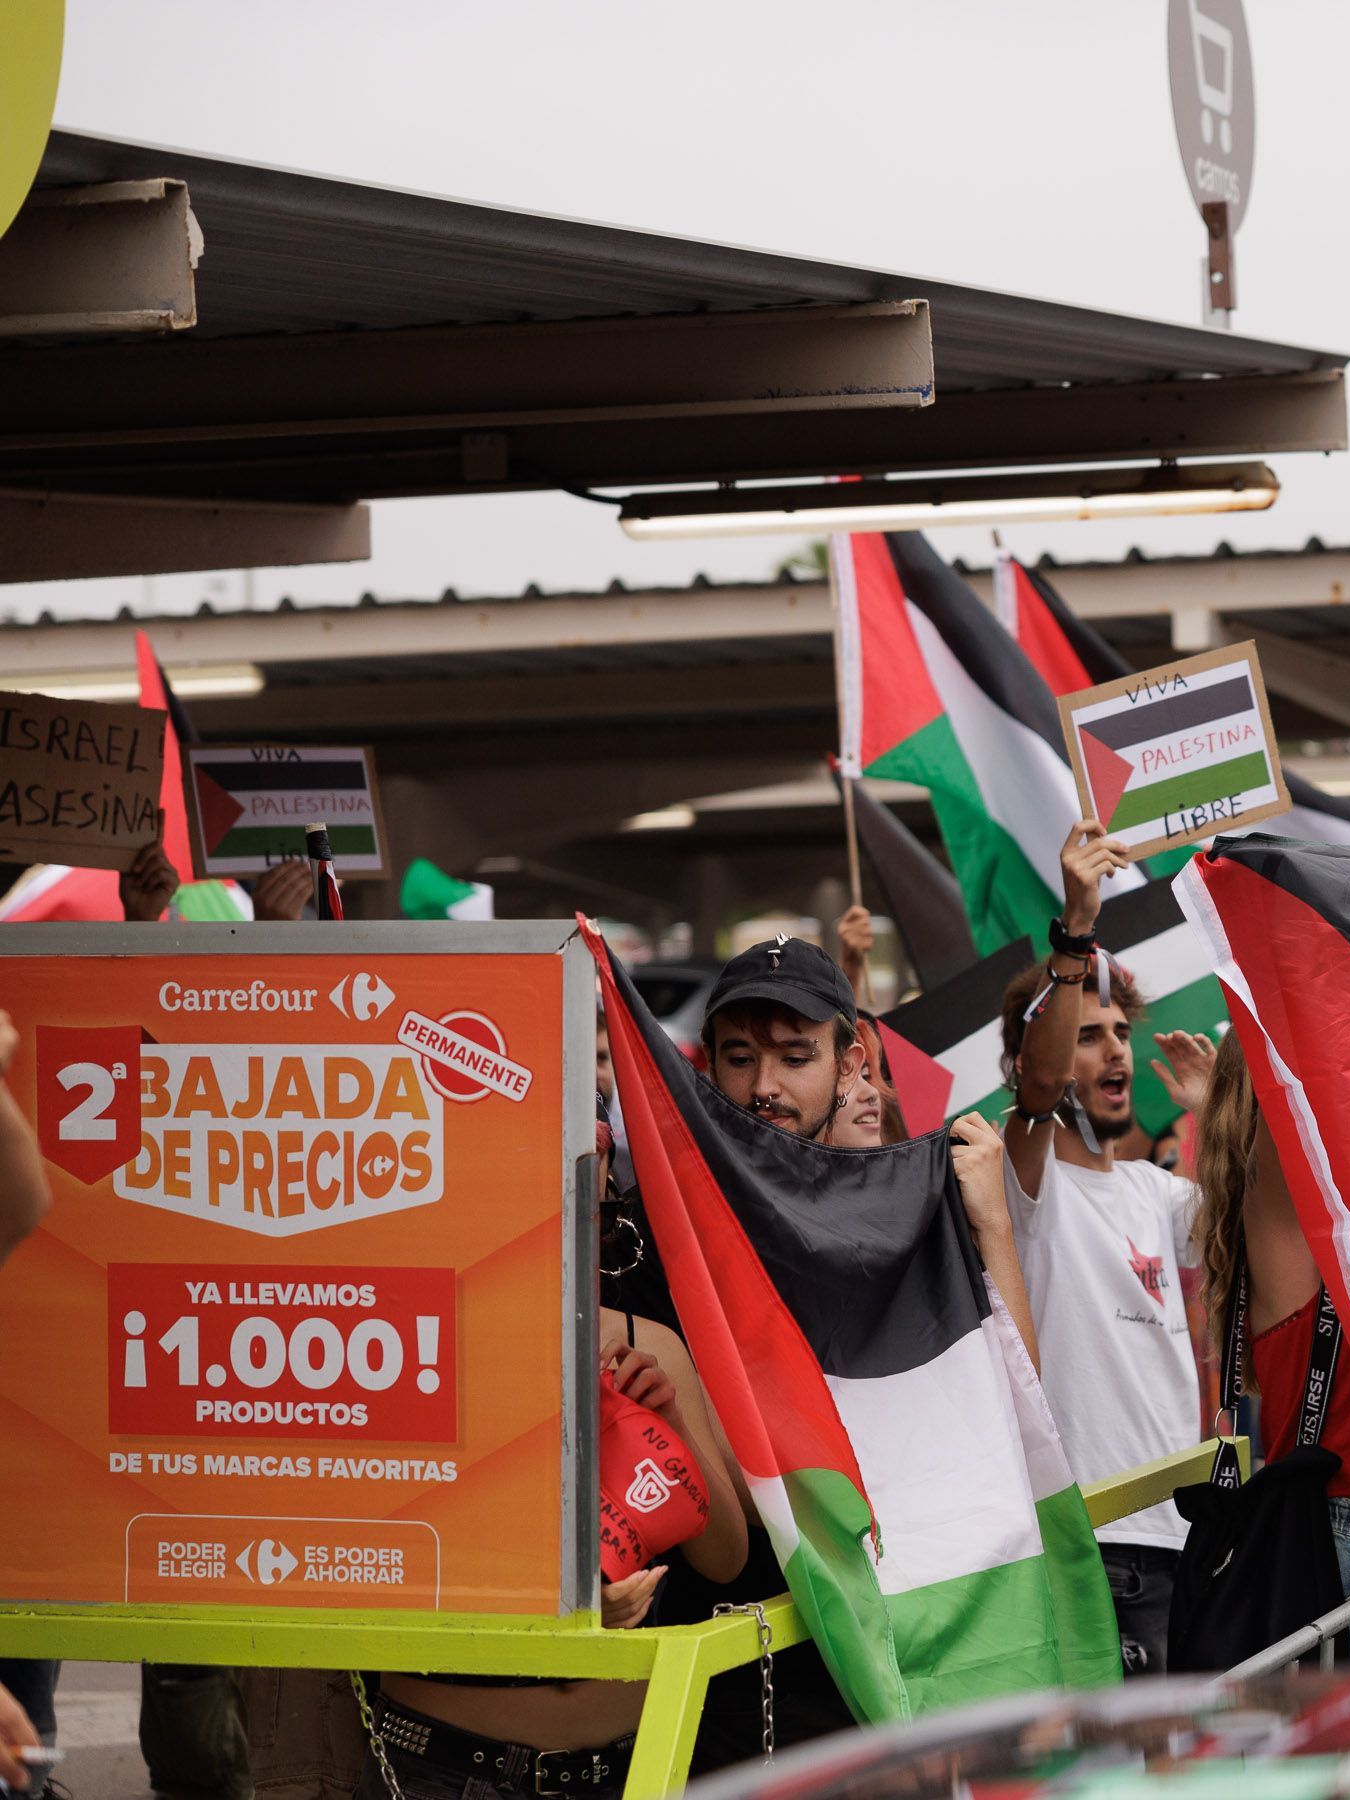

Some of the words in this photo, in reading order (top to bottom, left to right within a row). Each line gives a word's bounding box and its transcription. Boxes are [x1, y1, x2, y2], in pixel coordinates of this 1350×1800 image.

[0, 708, 148, 772] ISRAEL
[1141, 724, 1256, 774] PALESTINA
[251, 794, 371, 817] PALESTINA
[159, 979, 318, 1013] Carrefour
[403, 1017, 527, 1096] PERMANENTE
[55, 1059, 127, 1141] 2ª
[140, 1055, 431, 1120] BAJADA
[126, 1129, 192, 1197] DE
[207, 1130, 433, 1219] PRECIOS
[185, 1281, 222, 1305] YA
[228, 1282, 377, 1308] LLEVAMOS
[1322, 1288, 1336, 1314] M
[1318, 1318, 1333, 1337] SI
[122, 1309, 441, 1395] ¡1.000!
[1306, 1367, 1325, 1413] IRSE
[196, 1399, 369, 1427] PRODUCTOS
[643, 1427, 669, 1451] NO
[109, 1451, 142, 1474] DE
[147, 1453, 197, 1476] TUS
[203, 1454, 311, 1478] MARCAS
[318, 1457, 458, 1483] FAVORITAS
[158, 1541, 226, 1561] PODER
[304, 1546, 328, 1563] ES
[335, 1547, 404, 1566] PODER
[158, 1560, 226, 1580] ELEGIR
[304, 1564, 404, 1585] AHORRAR
